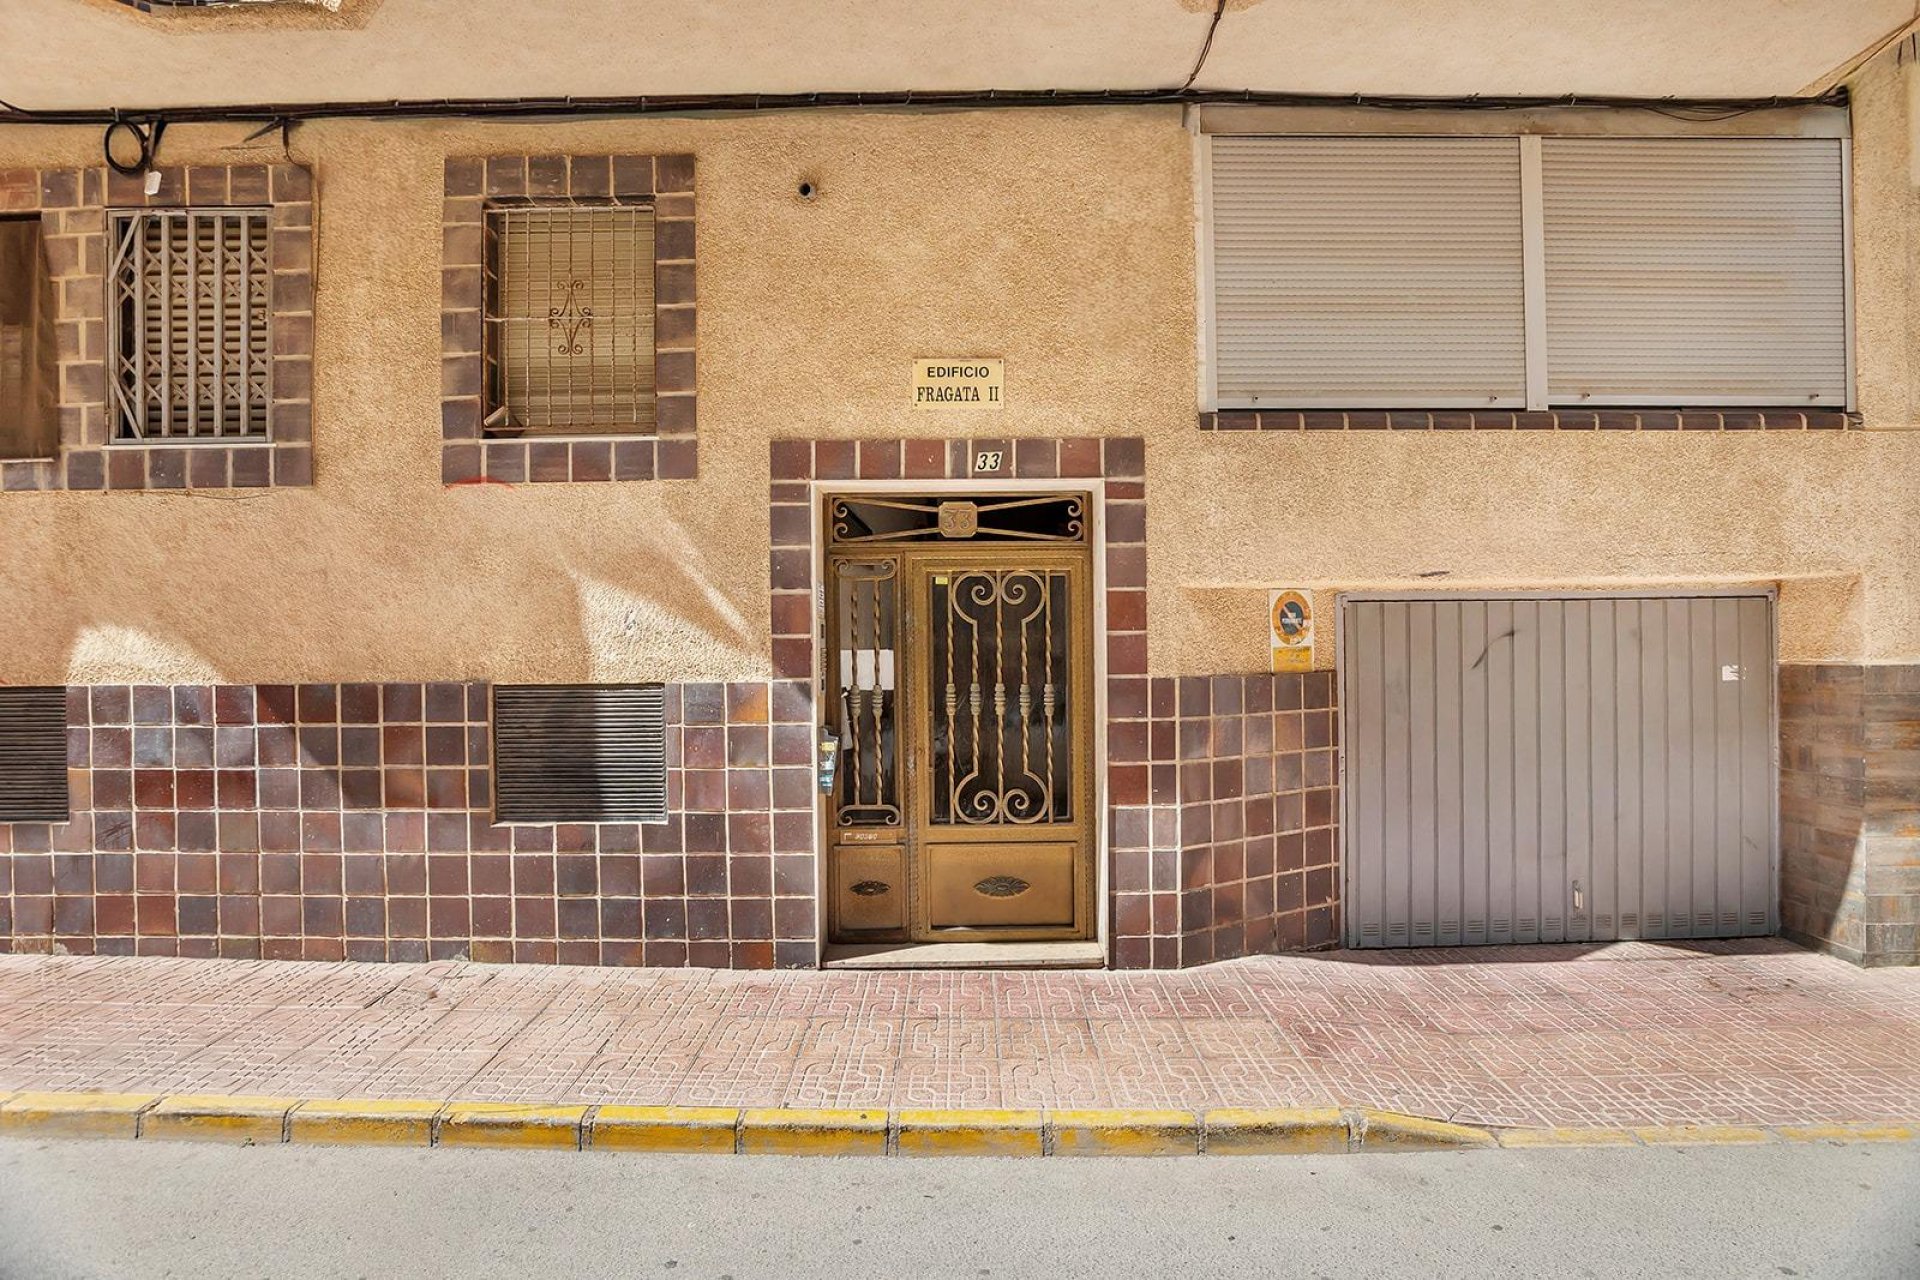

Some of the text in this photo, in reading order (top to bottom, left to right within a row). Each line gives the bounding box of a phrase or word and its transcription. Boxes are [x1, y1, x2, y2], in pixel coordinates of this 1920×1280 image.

[927, 366, 989, 378] EDIFICIO
[917, 386, 999, 402] FRAGATA II
[977, 452, 1000, 470] 33
